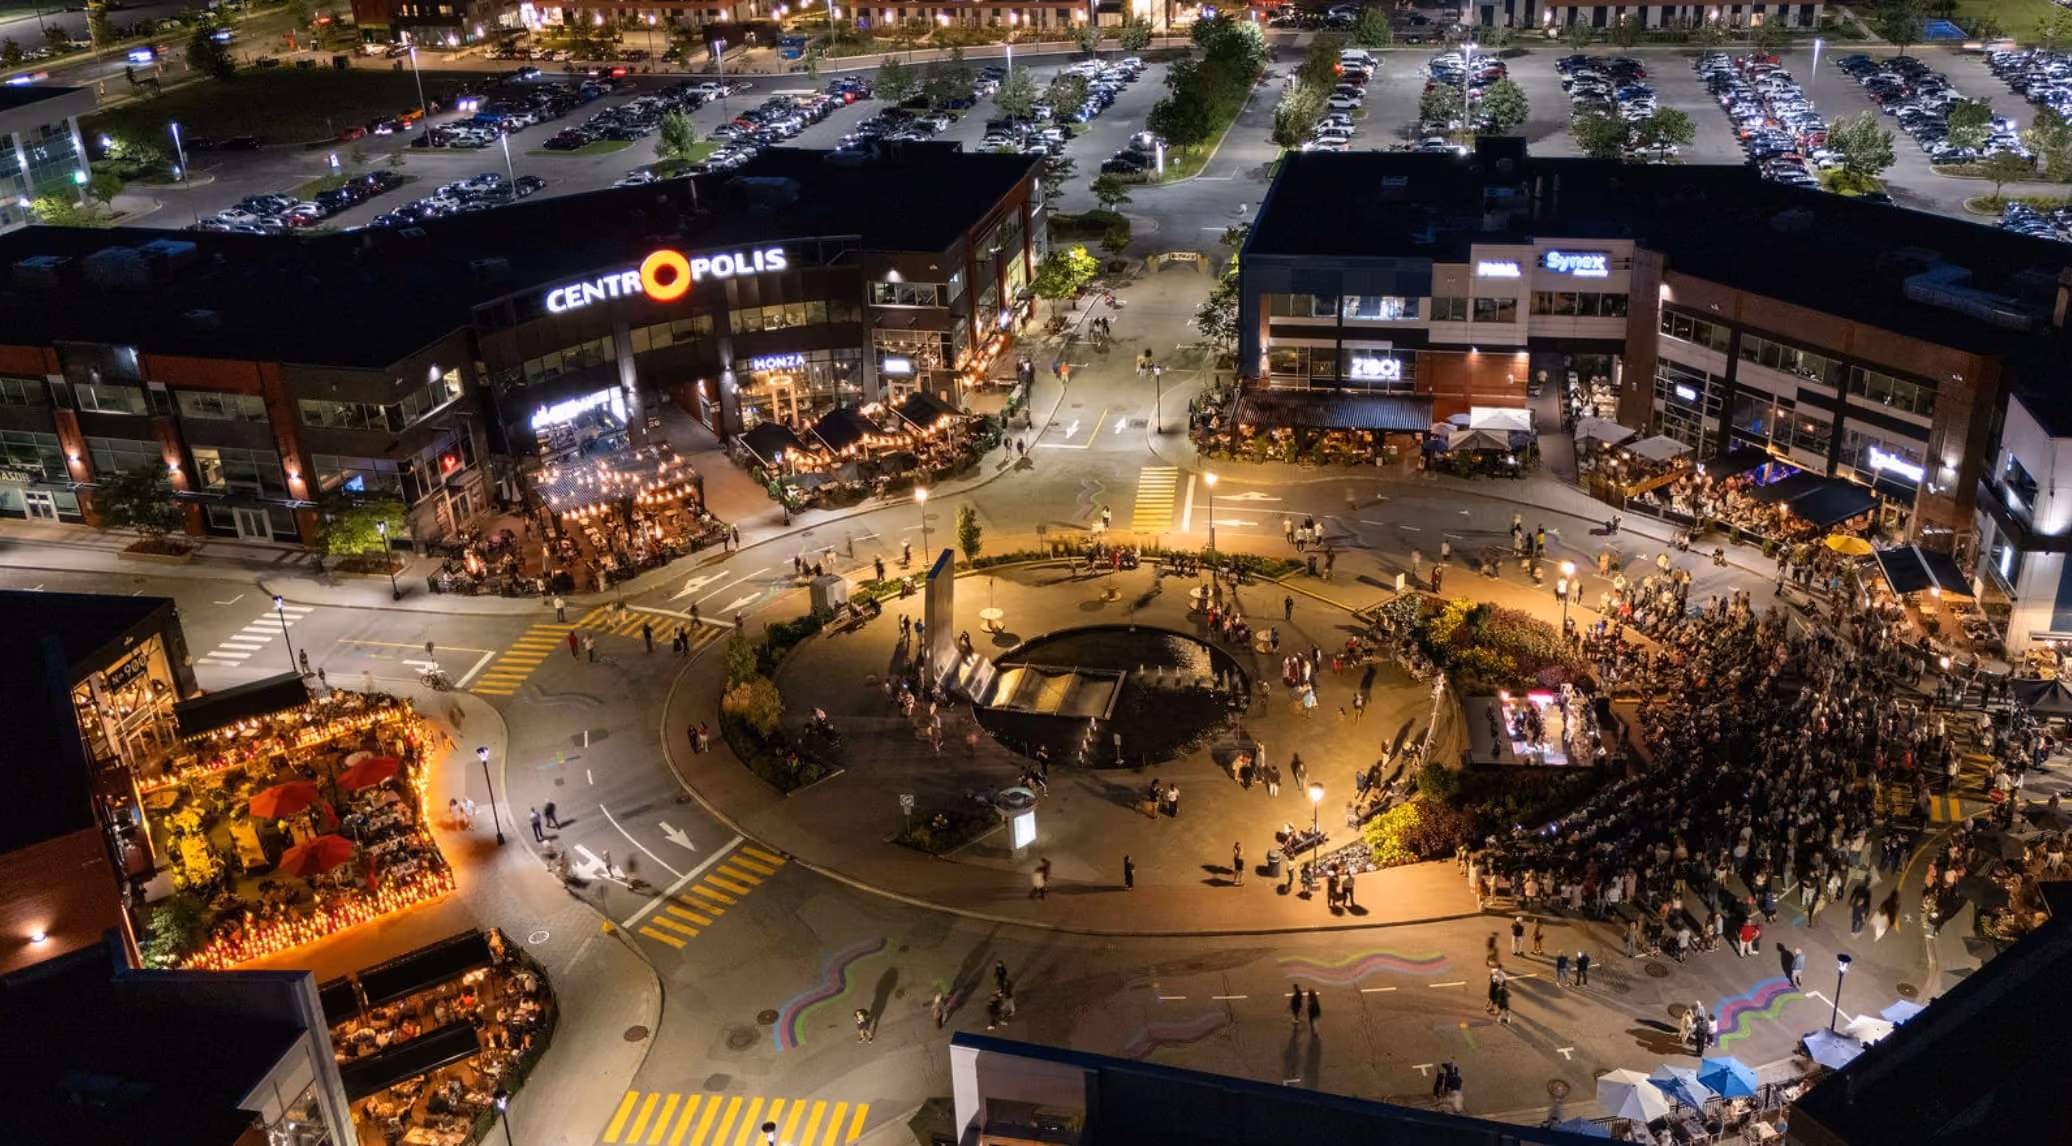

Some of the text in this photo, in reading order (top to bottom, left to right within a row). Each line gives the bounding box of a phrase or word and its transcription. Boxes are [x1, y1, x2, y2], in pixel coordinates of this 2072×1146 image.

[1546, 251, 1606, 272] Synex
[546, 248, 787, 313] CENTROPOLIS
[754, 354, 806, 370] MONZA
[123, 654, 146, 677] 900
